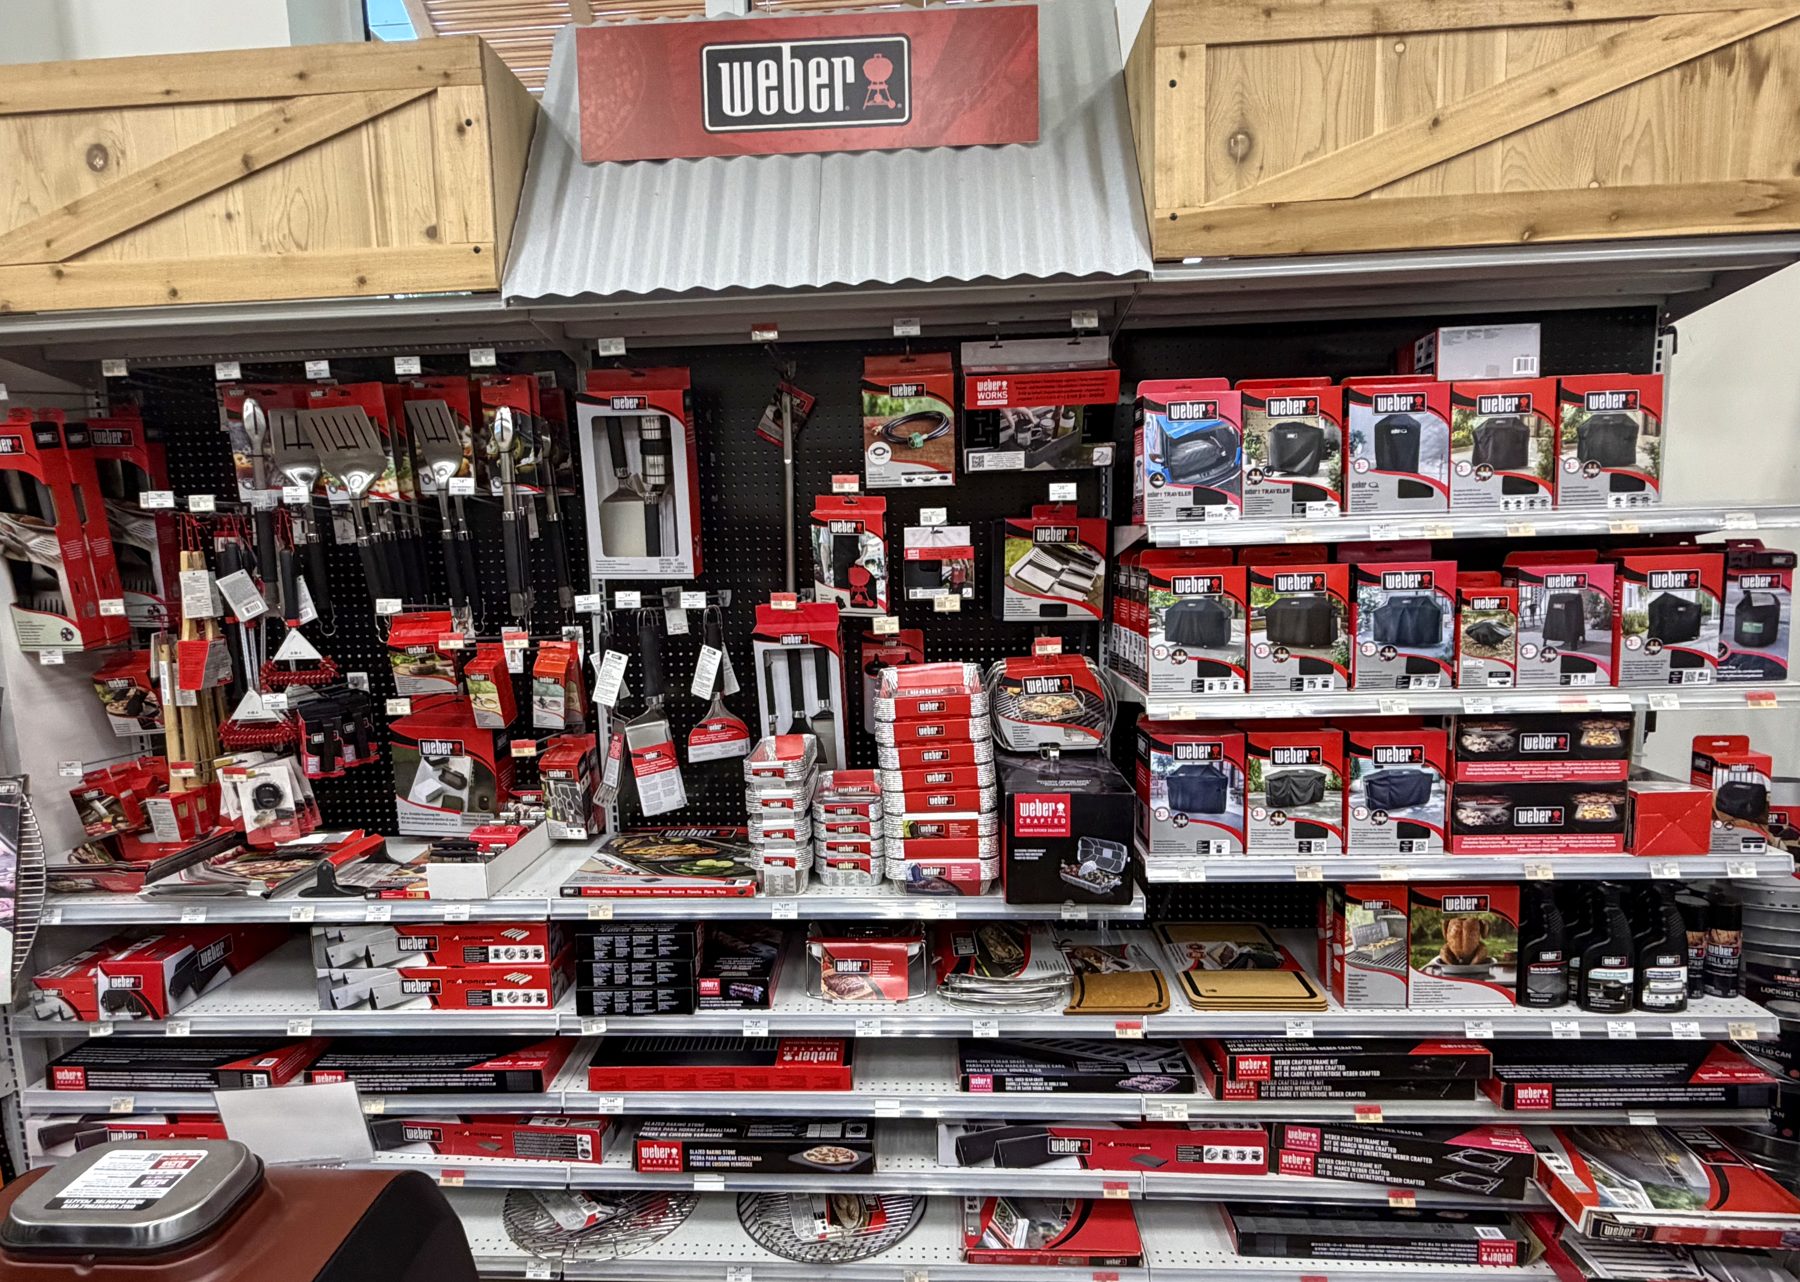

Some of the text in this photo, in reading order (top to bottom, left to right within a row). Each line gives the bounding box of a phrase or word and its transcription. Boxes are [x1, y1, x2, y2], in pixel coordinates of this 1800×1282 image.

[718, 44, 855, 117] weber
[892, 384, 917, 397] weber
[977, 379, 1001, 392] weber
[977, 392, 1008, 400] WORKS
[1377, 394, 1414, 412] weber
[1589, 391, 1627, 409] weber
[613, 397, 639, 410] weber
[1171, 402, 1207, 419] weber
[1270, 399, 1306, 416] weber
[1481, 395, 1518, 413] weber
[1261, 487, 1291, 495] TRAVELER
[830, 520, 856, 535] weber
[1037, 525, 1068, 541] weber
[1175, 575, 1211, 593] weber
[1277, 573, 1313, 591] weber
[1385, 571, 1421, 589] weber
[1547, 574, 1577, 588] weber
[1651, 571, 1688, 589] weber
[1741, 574, 1769, 588] weber
[1473, 596, 1499, 609] weber
[407, 645, 428, 655] weber
[1025, 676, 1062, 694] weber
[919, 702, 939, 711] weber
[919, 726, 938, 736] weber
[422, 740, 453, 756] weber
[1522, 734, 1558, 751] weber
[923, 751, 943, 761] weber
[1176, 741, 1212, 759] weber
[1274, 746, 1310, 764] weber
[1376, 746, 1412, 763] weber
[549, 769, 567, 779] weber
[926, 773, 946, 783] weber
[523, 793, 538, 803] weber
[929, 795, 948, 805] weber
[1019, 798, 1056, 817] weber
[1019, 817, 1066, 825] CRAFTED
[1518, 807, 1552, 824] weber
[664, 828, 717, 838] weber
[920, 824, 939, 834] weber
[922, 867, 941, 877] weber
[1364, 899, 1384, 910] weber
[1445, 895, 1478, 912] weber
[399, 937, 429, 951] weber
[1708, 944, 1737, 958] weber
[835, 958, 862, 972] weber
[111, 977, 135, 989] weber
[402, 978, 432, 994] weber
[795, 1050, 839, 1064] weber
[1775, 1049, 1792, 1060] CAN
[1239, 1058, 1262, 1070] weber
[1274, 1070, 1380, 1078] KIT DE CADRE ET ENTRETOISE WEBER CRAFTED
[1518, 1086, 1542, 1100] weber
[406, 1126, 433, 1140] weber
[1287, 1128, 1311, 1141] weber
[641, 1144, 671, 1159] weber
[1051, 1138, 1081, 1153] weber
[1282, 1152, 1305, 1165] weber
[1604, 1224, 1636, 1237] weber
